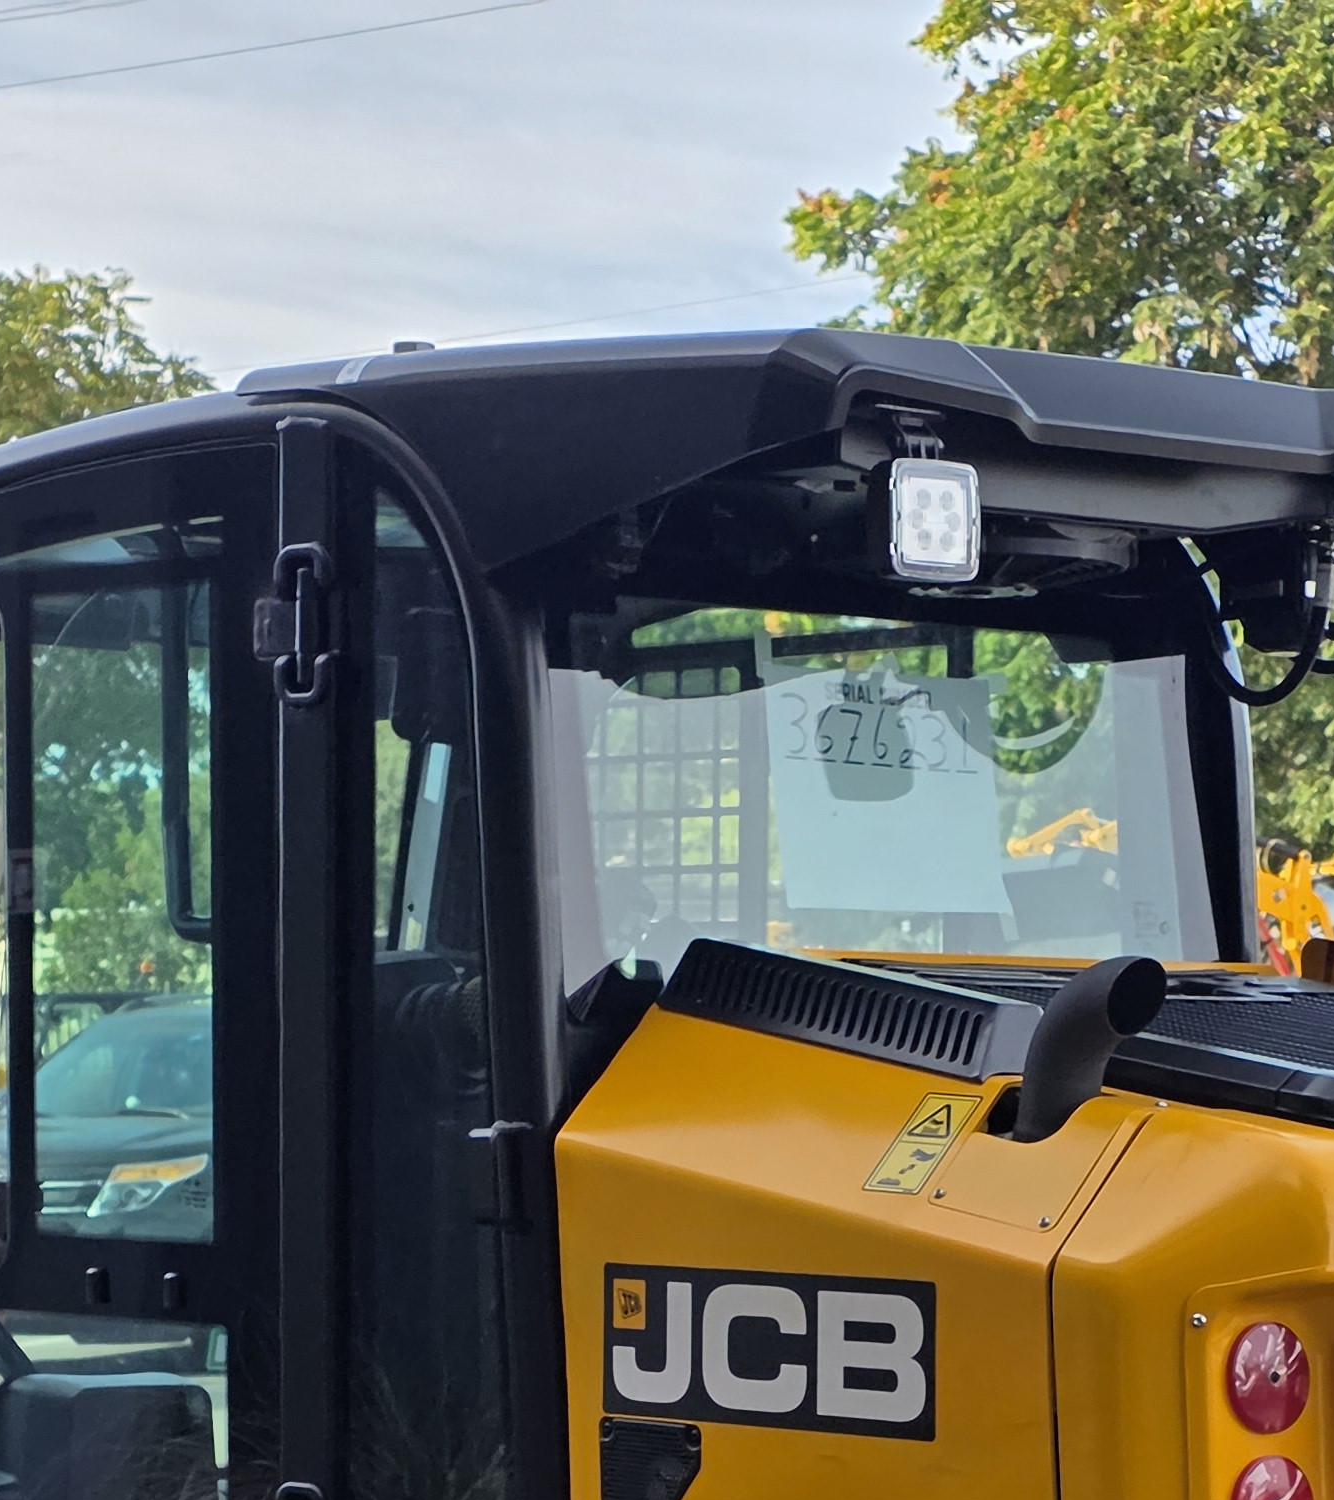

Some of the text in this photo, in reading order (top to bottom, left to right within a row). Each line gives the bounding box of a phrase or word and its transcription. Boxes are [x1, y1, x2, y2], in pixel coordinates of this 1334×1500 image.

[781, 692, 968, 770] 3676231
[824, 682, 874, 704] SERIAL
[612, 1281, 927, 1423] JCB
